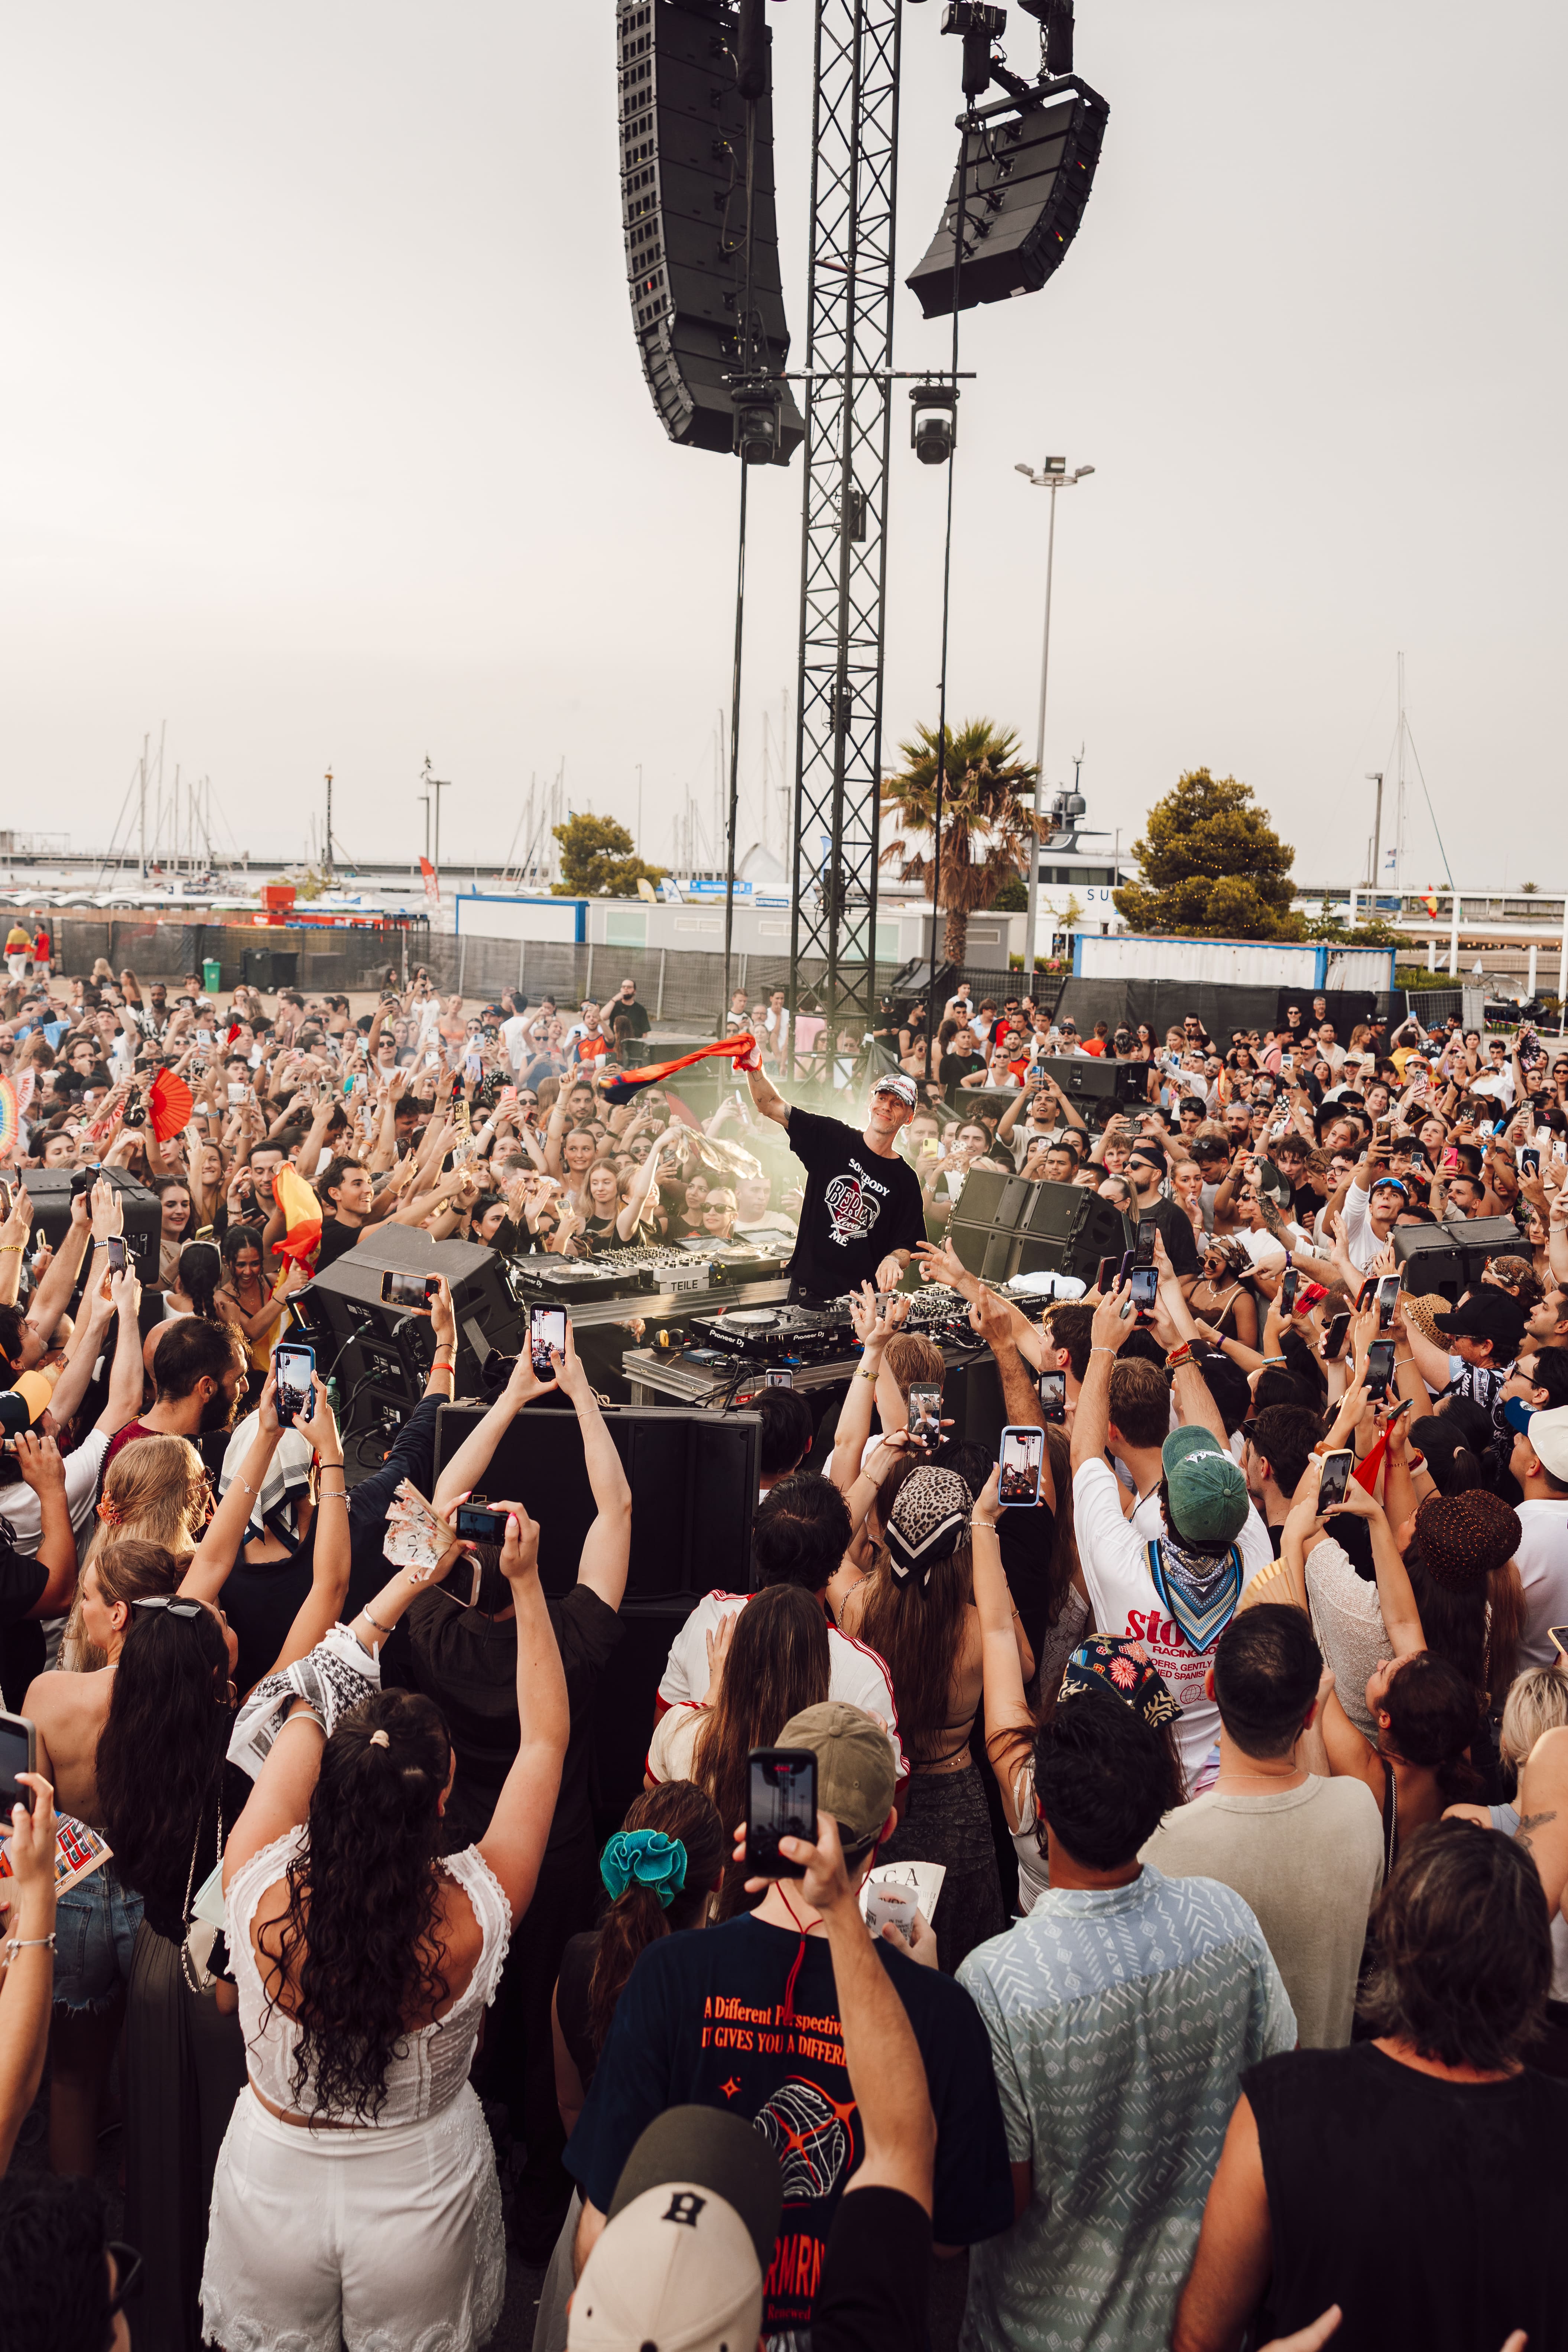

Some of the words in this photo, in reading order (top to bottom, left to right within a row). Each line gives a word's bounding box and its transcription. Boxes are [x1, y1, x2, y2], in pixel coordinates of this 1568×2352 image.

[828, 1230, 849, 1247] ME
[671, 1280, 698, 1291] TEILE
[709, 1329, 736, 1343] Pioneer
[1153, 1646, 1199, 1658] RACING
[1148, 1657, 1178, 1672] OERS,
[1180, 1660, 1212, 1672] GENTLY
[704, 1997, 712, 2018] A
[715, 1996, 772, 2025] Different
[702, 2027, 713, 2048] IT
[715, 2027, 753, 2051] GIVES
[757, 2033, 783, 2053] YOU
[786, 2034, 795, 2054] A
[767, 2303, 811, 2321] Renewed
